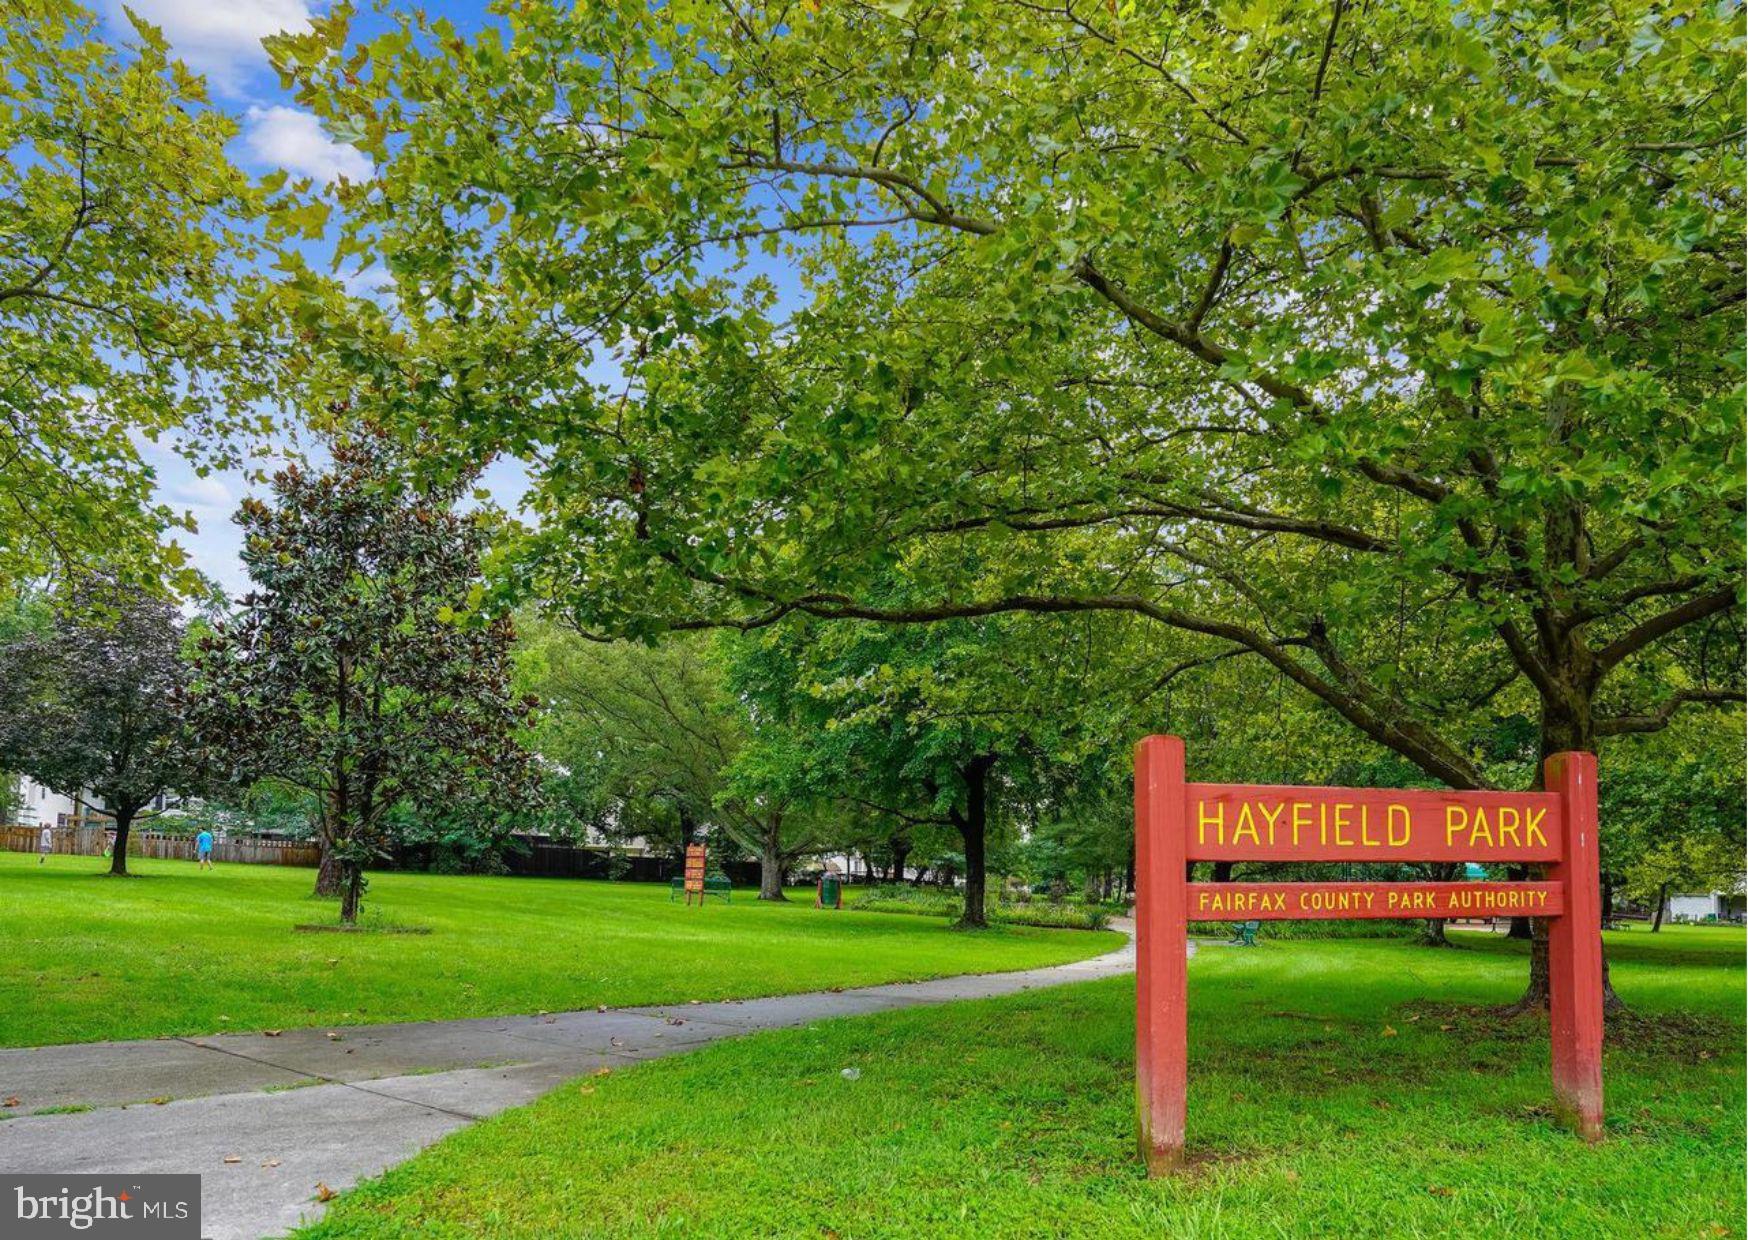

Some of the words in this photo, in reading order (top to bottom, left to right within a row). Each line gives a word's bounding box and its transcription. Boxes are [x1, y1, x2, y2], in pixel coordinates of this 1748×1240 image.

[1198, 801, 1411, 847] HAYFIELD
[1446, 805, 1548, 848] PARK
[1199, 892, 1286, 912] FAIRFAX
[1299, 891, 1375, 911] COUNTY
[1388, 891, 1436, 909] PARK
[1448, 890, 1547, 909] AUTHORITY
